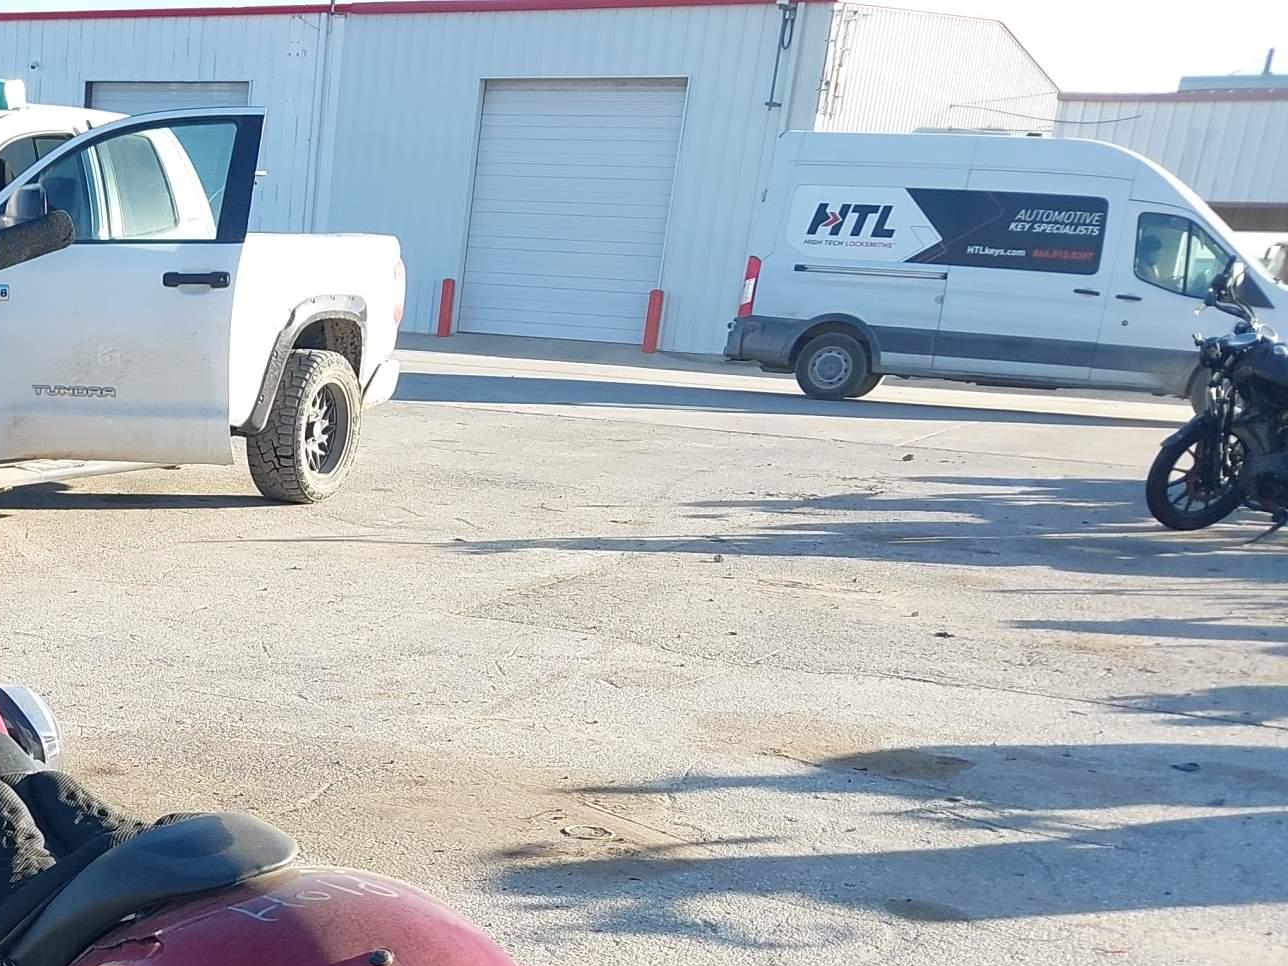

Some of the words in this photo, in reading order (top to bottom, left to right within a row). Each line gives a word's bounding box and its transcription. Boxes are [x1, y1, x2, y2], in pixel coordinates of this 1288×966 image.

[806, 202, 896, 238] HTL
[1014, 208, 1104, 225] AUTOMOTIVE
[1008, 221, 1032, 232] KEY
[1032, 223, 1101, 236] SPECIALISTS
[824, 239, 844, 247] TECH
[966, 245, 1026, 256] HTLkeys.com
[32, 384, 117, 398] TUNDRA
